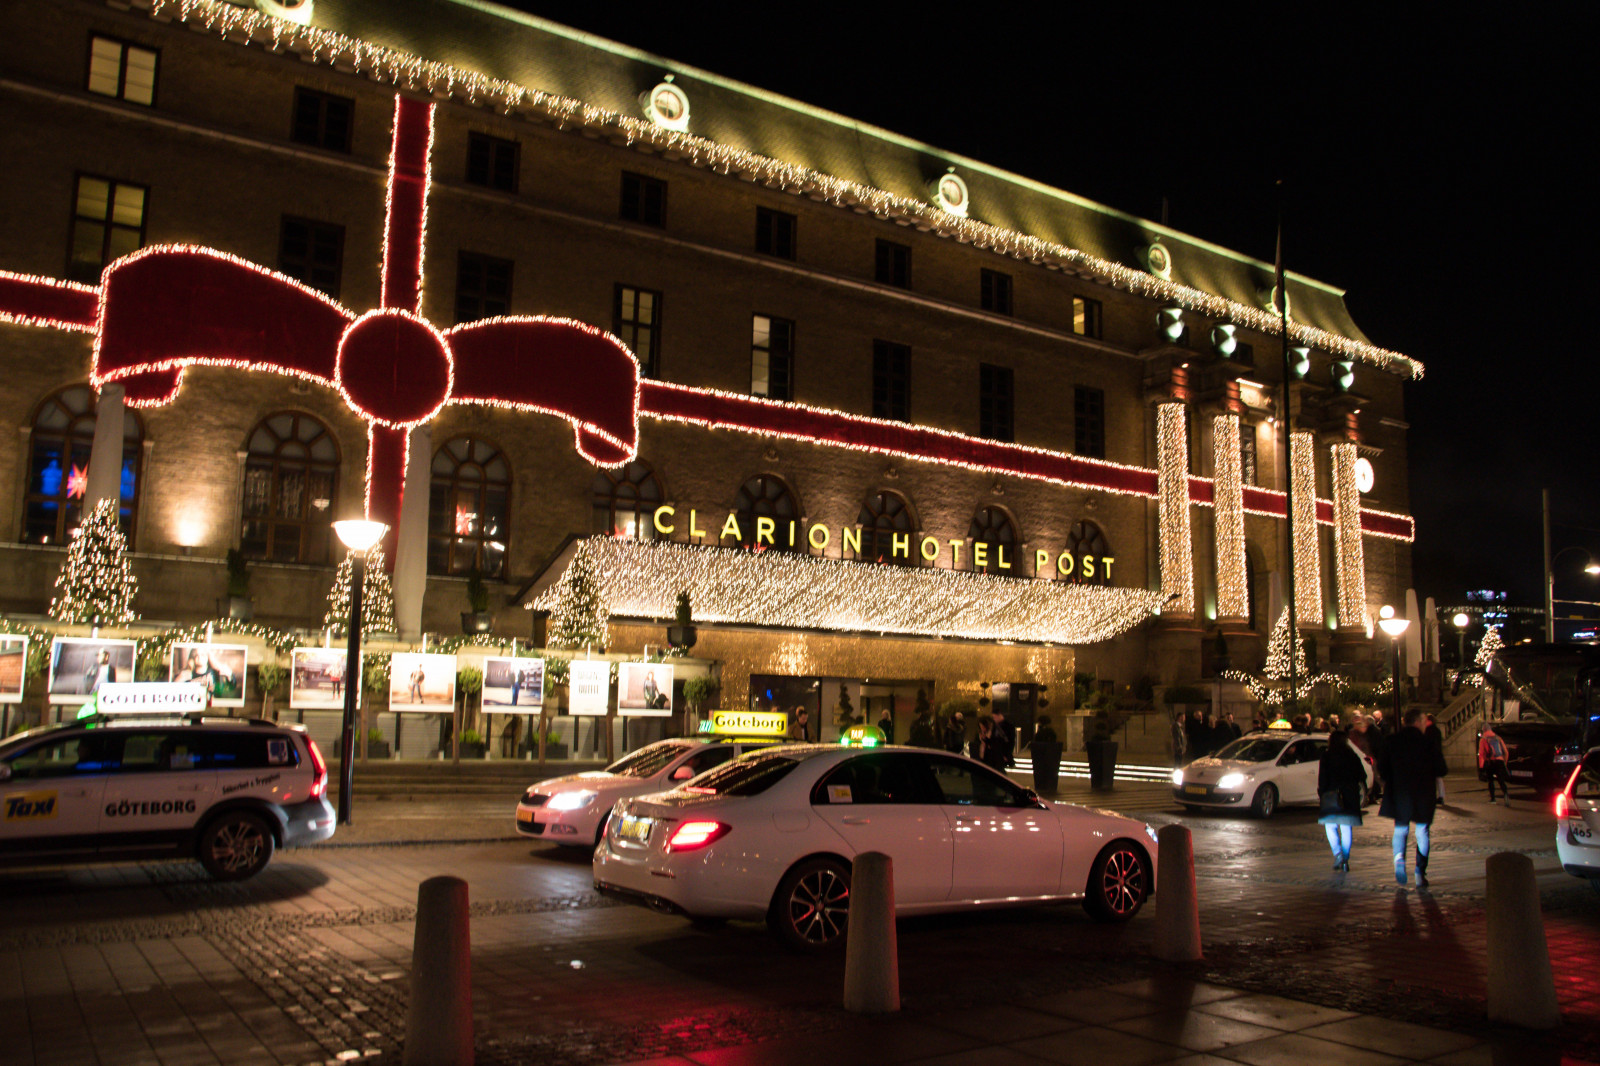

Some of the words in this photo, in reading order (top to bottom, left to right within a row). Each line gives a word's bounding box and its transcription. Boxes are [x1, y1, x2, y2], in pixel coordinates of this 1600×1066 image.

[653, 505, 862, 553] CLARION
[892, 532, 1011, 569] HOTEL
[1036, 549, 1114, 579] POST
[6, 797, 56, 818] Taxi
[105, 799, 197, 817] GÖTEBORG
[1572, 827, 1593, 838] 465
